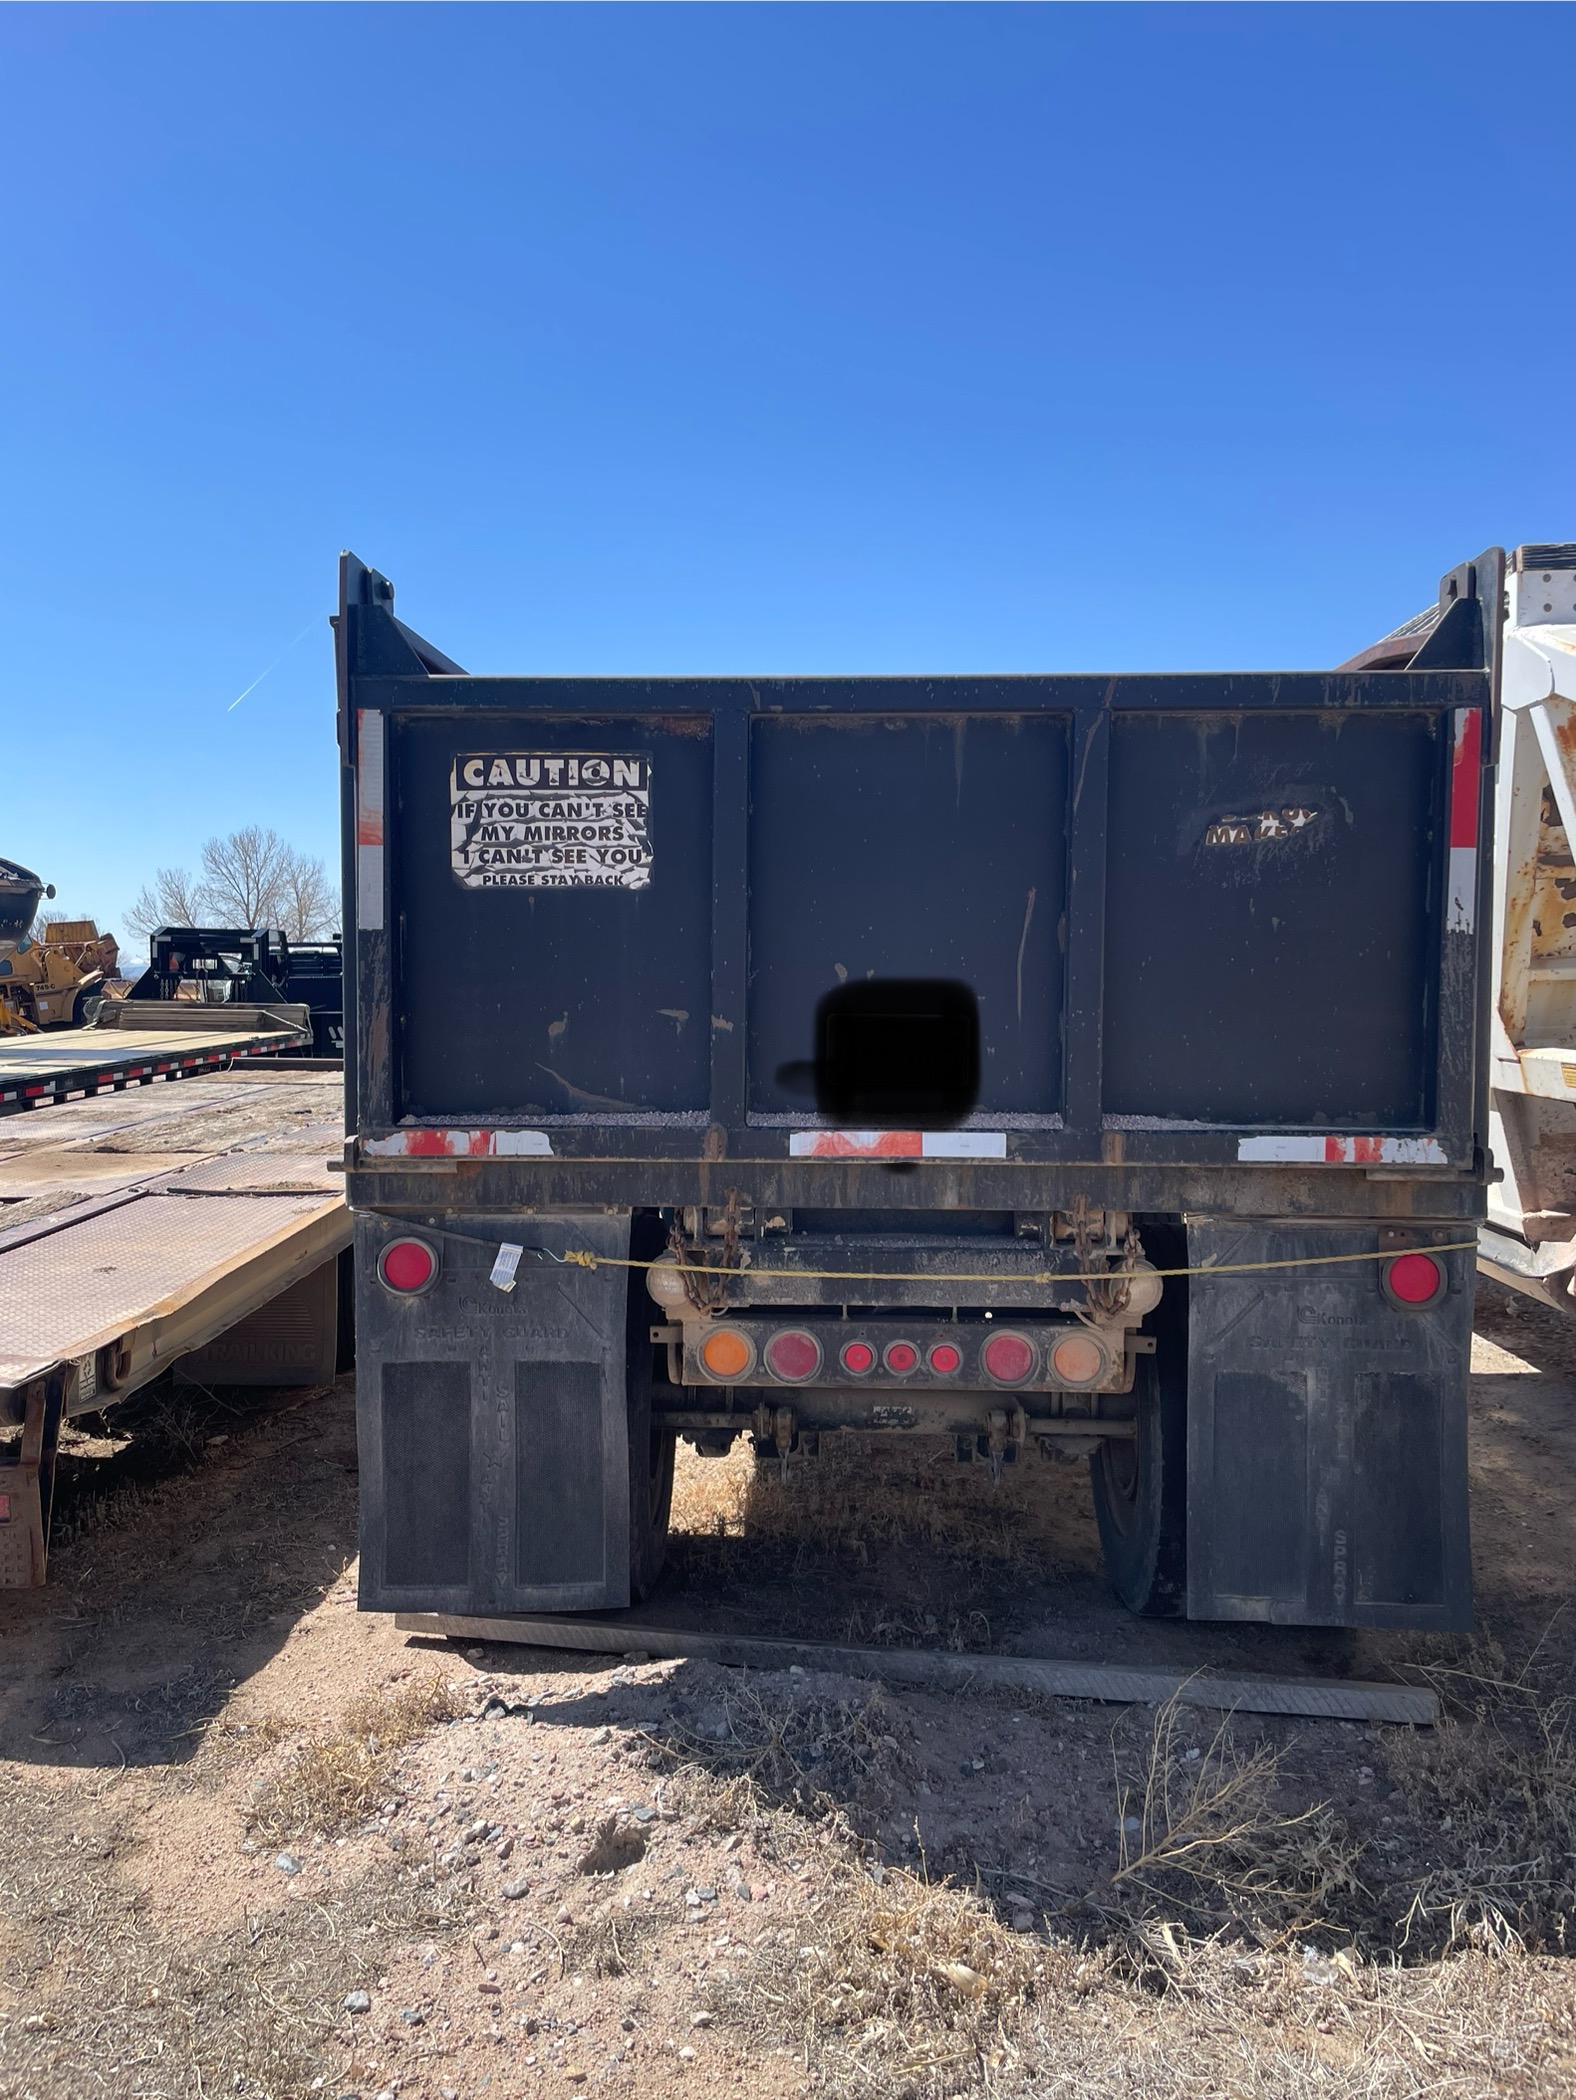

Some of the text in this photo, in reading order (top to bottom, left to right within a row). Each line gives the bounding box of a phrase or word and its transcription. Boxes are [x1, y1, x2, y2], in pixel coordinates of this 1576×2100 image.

[463, 759, 640, 787] CAUTION
[457, 802, 647, 818] IF YOU CAN'T SEE
[481, 826, 625, 841] MY MIRRORS
[478, 849, 543, 864] CAN'T
[551, 849, 587, 864] SEE
[599, 849, 642, 864] YOU
[482, 875, 624, 886] PLEASE STAY BACK
[414, 1325, 570, 1339] SAFETY GUARD
[1249, 1336, 1330, 1350] SAFETY
[262, 1343, 316, 1361] KING
